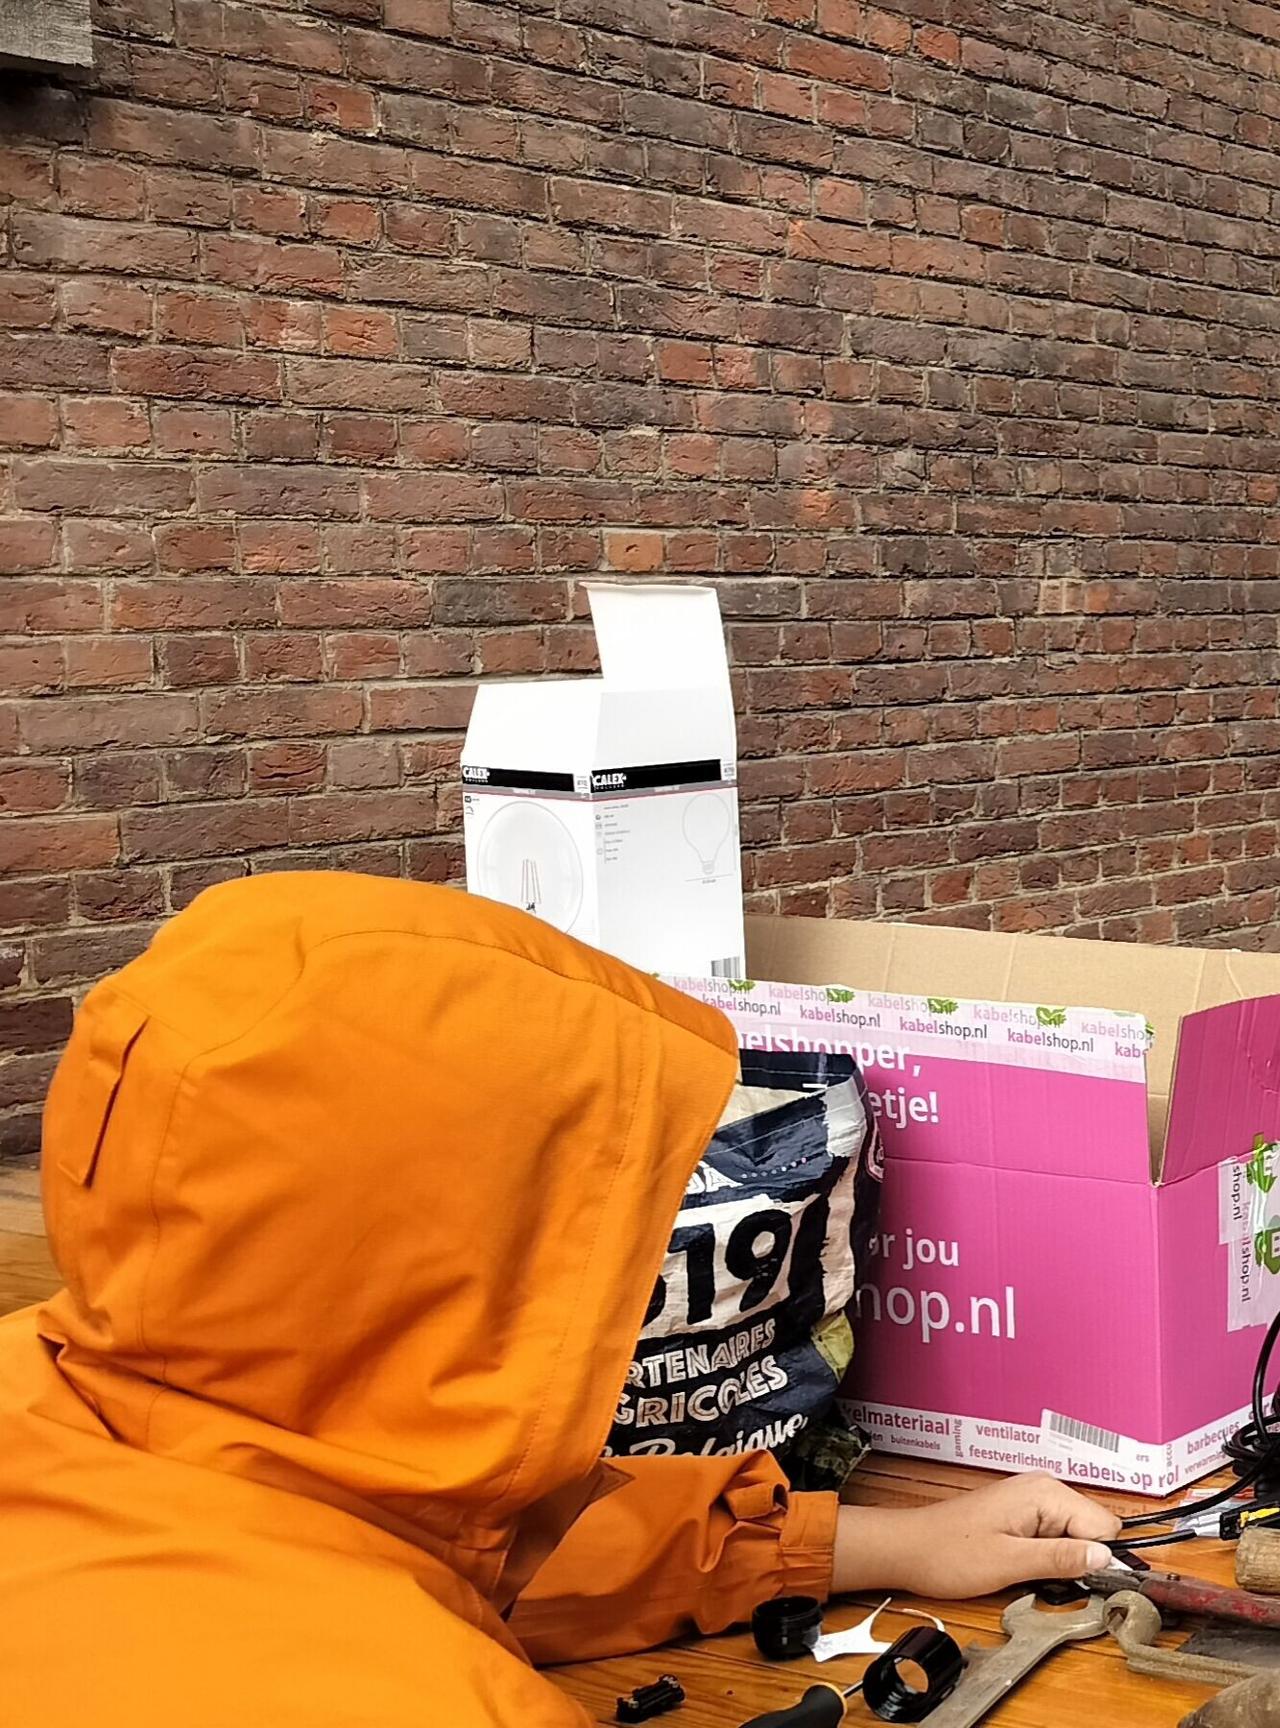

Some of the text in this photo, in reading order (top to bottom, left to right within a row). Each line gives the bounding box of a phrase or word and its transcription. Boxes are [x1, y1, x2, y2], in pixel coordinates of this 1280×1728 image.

[594, 773, 624, 786] CALEX
[800, 1005, 881, 1029] kabelshop.nl
[900, 1017, 988, 1040] kabelshop.nl
[1008, 1028, 1094, 1053] kabelshop.nl
[868, 1086, 939, 1128] etje!
[1231, 1161, 1243, 1220] shop.nl
[902, 1228, 959, 1270] jou
[642, 1208, 792, 1326] 19
[626, 1317, 776, 1388] RTENAIRES
[612, 1354, 788, 1428] GRICOLES
[890, 1434, 941, 1451] buitenkabels
[953, 1418, 964, 1457] gaming
[976, 1423, 1041, 1444] ventilator
[1186, 1420, 1241, 1455] barbecues
[969, 1445, 1063, 1474] feestverlichting
[1136, 1453, 1150, 1463] ers
[1158, 1465, 1179, 1488] rol
